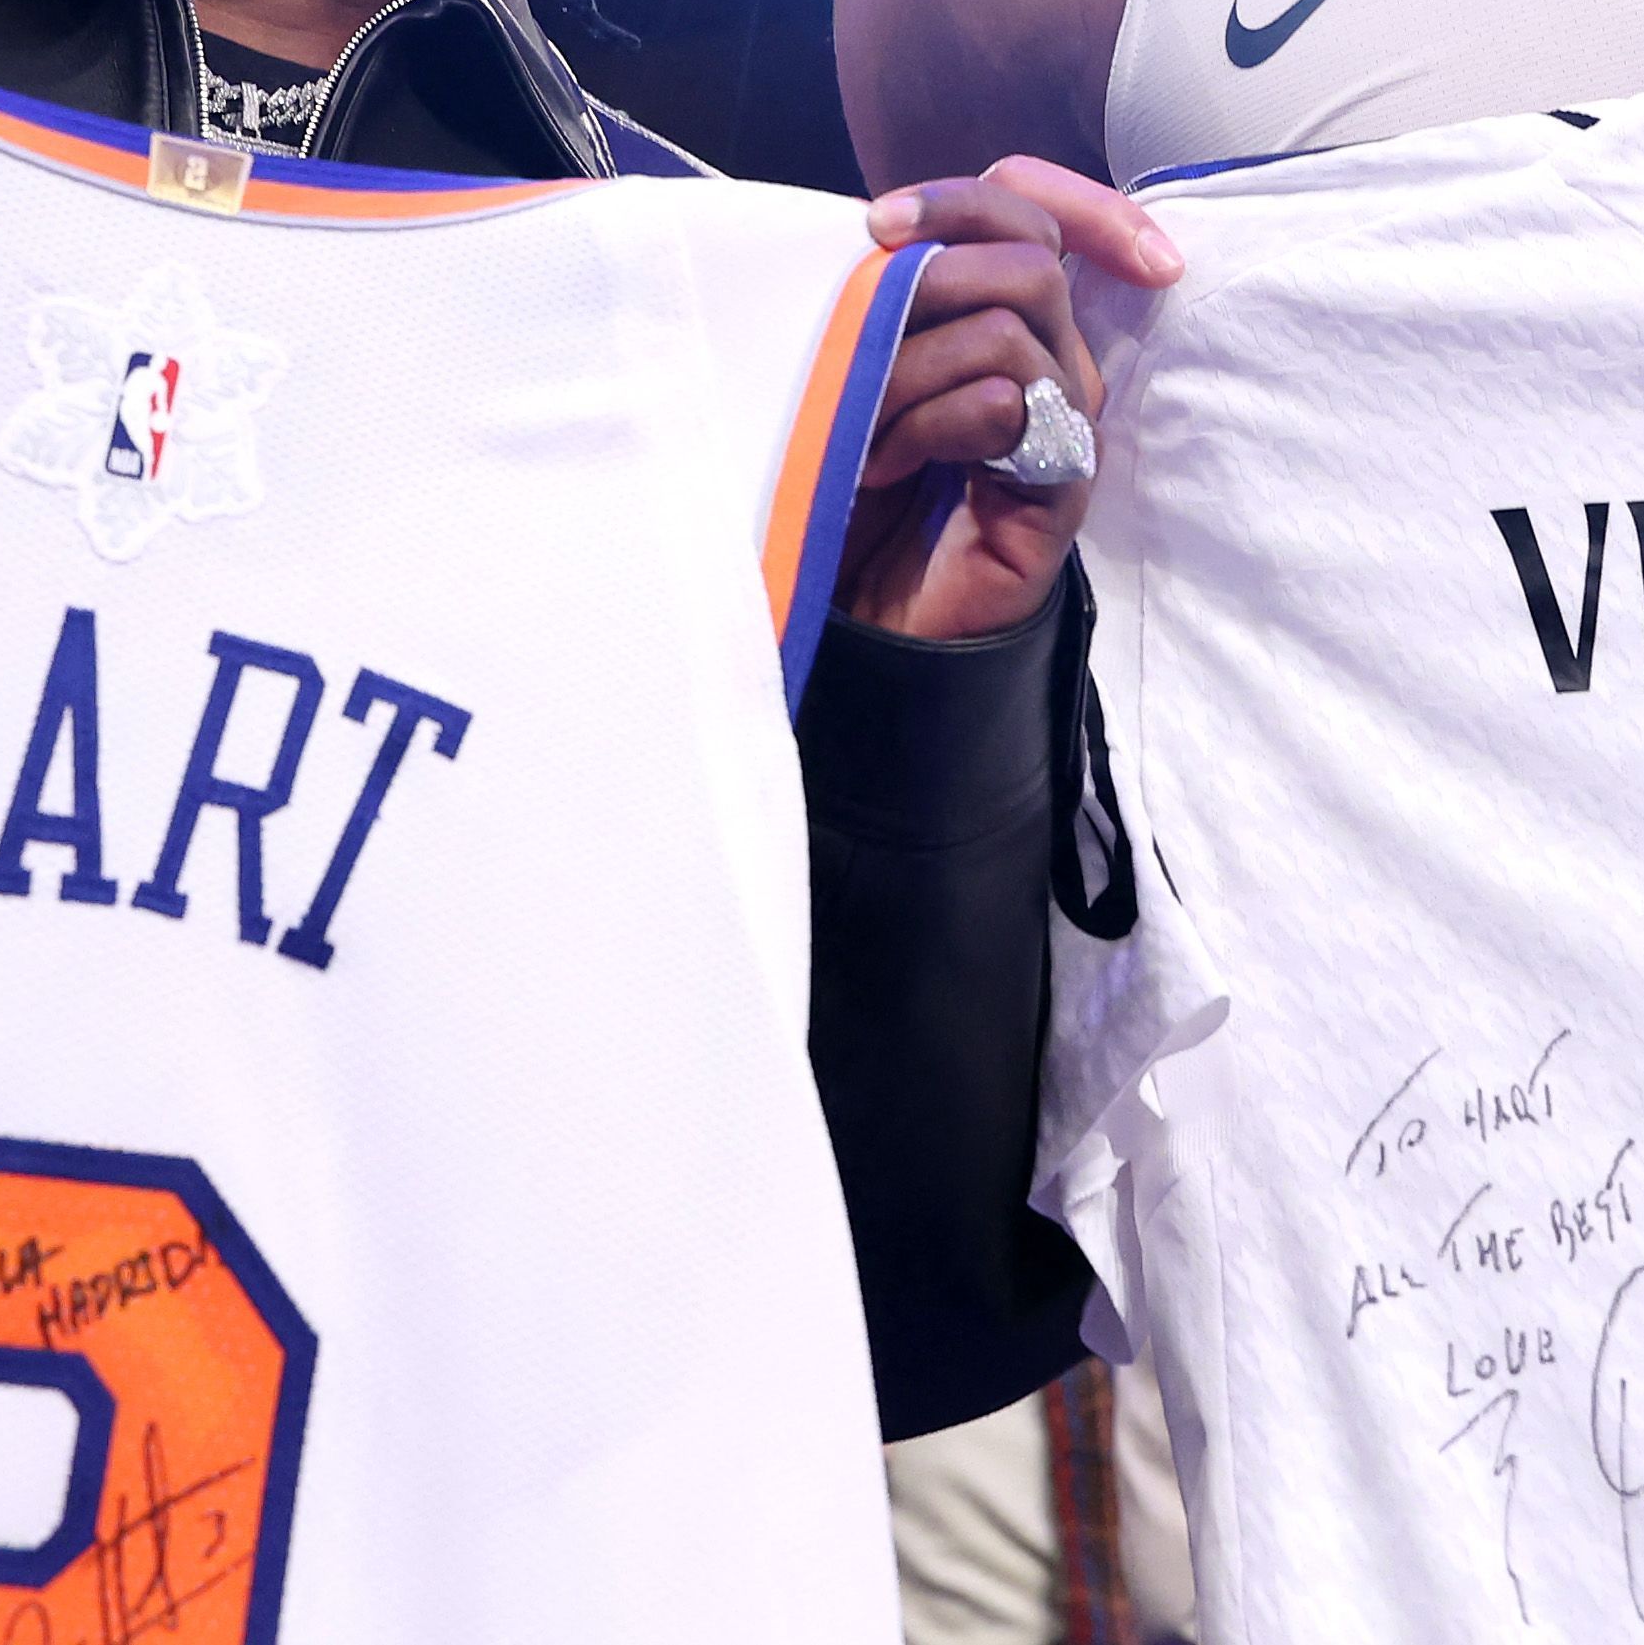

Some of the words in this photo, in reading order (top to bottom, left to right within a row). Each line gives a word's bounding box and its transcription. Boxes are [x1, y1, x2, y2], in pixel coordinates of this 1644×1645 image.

[1464, 1029, 1571, 1143] HART
[1346, 1262, 1428, 1340] ALL
[1437, 1182, 1525, 1273] THE
